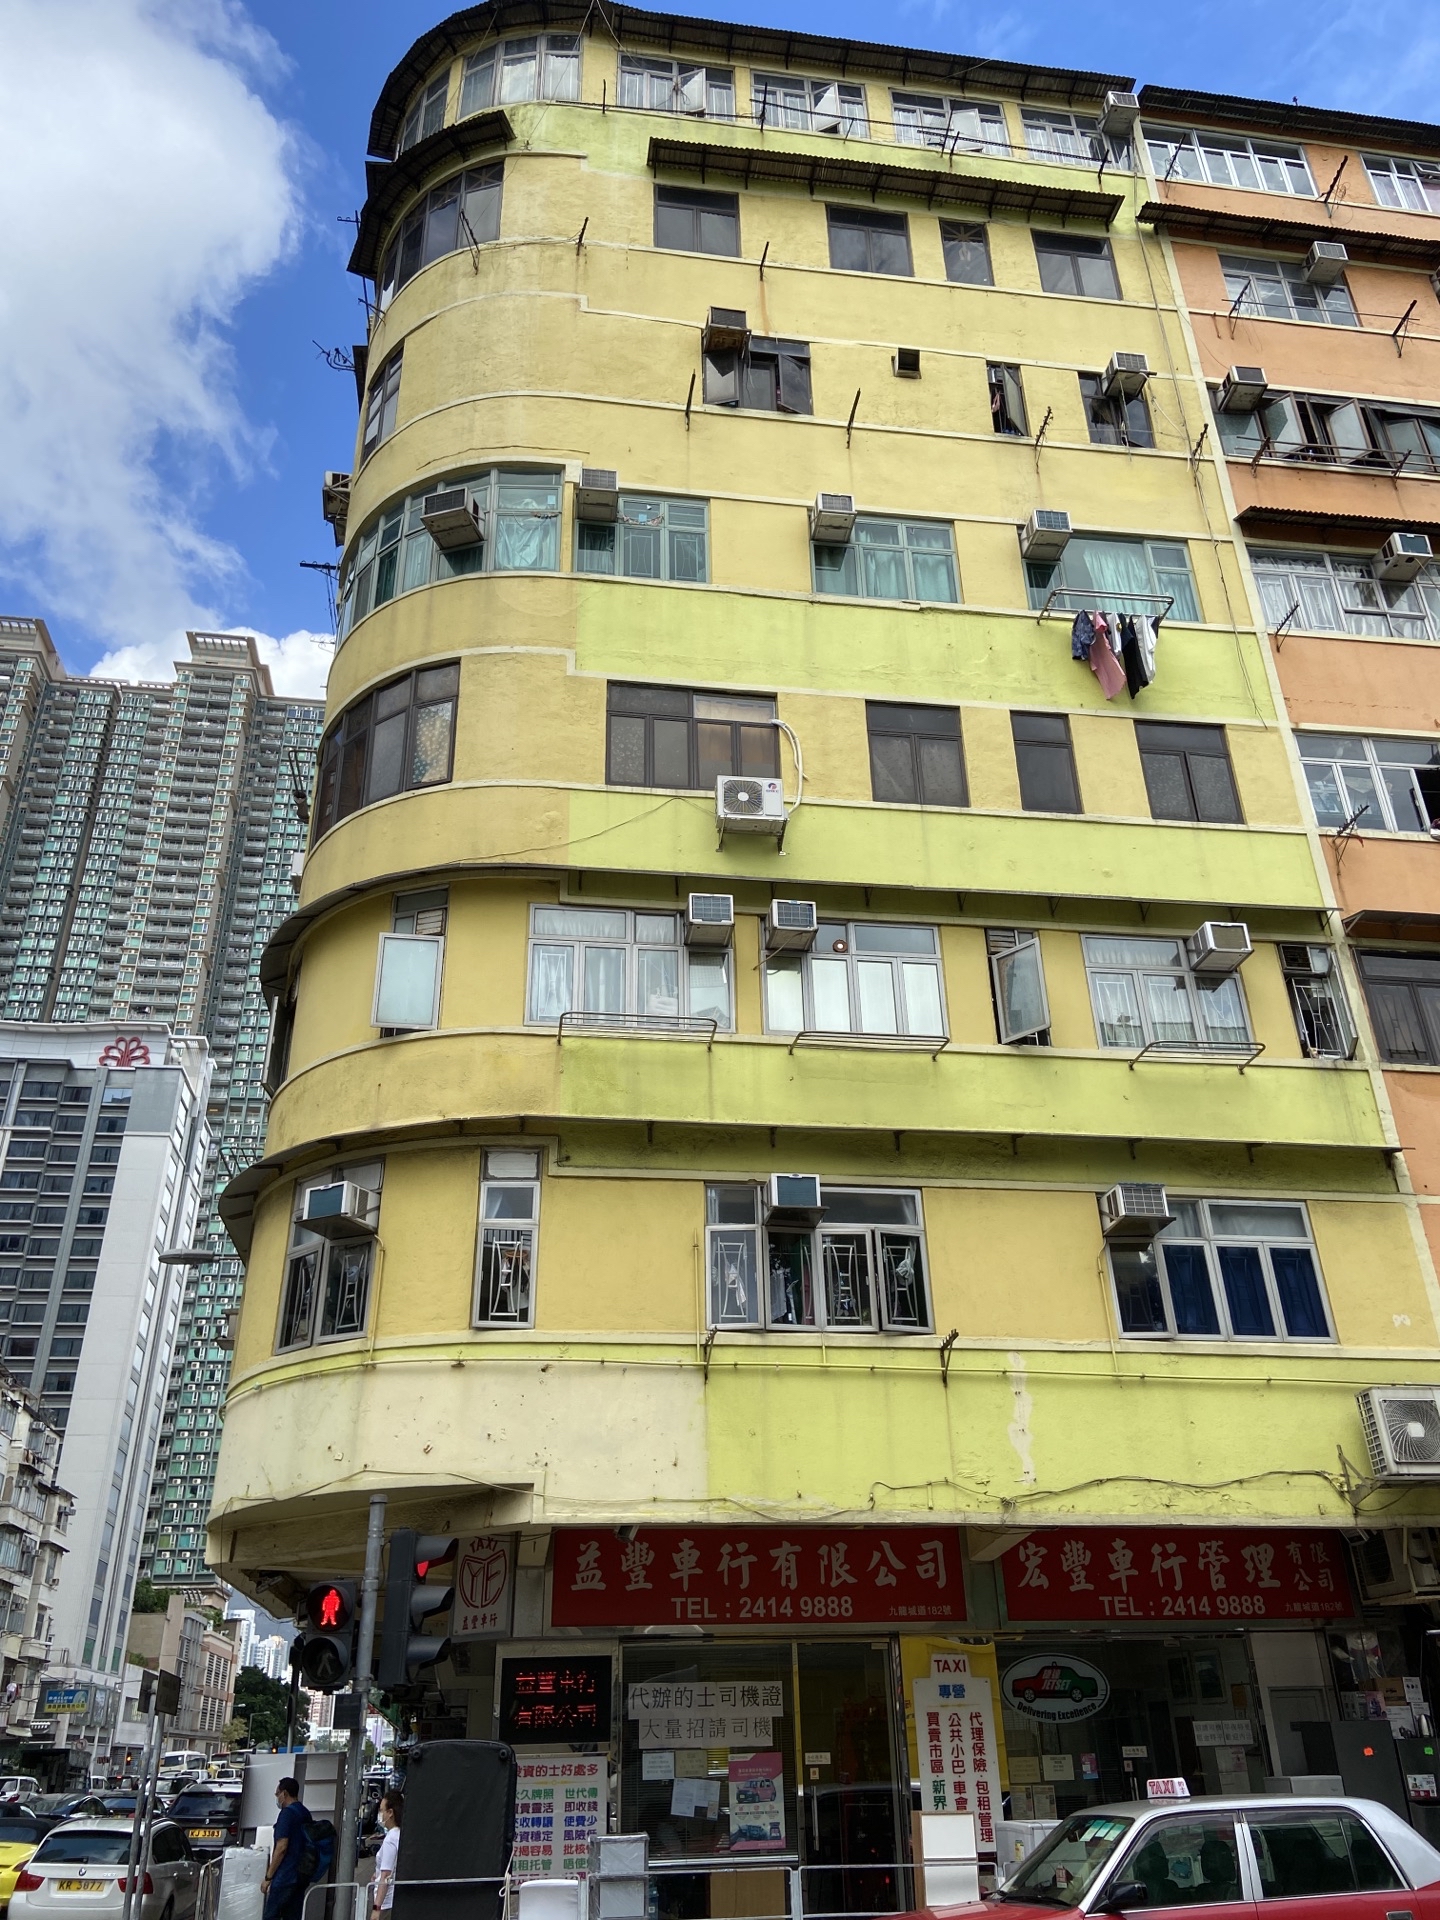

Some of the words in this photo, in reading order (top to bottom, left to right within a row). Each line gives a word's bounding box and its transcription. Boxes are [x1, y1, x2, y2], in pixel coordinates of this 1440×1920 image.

[469, 1536, 498, 1553] TAXI
[1286, 1541, 1331, 1565] 有限
[571, 1538, 947, 1592] 益豐車行有限公司
[1017, 1538, 1281, 1594] 宏豐車行管理
[1293, 1568, 1334, 1592] 公司
[739, 1596, 793, 1618] 2414
[800, 1596, 853, 1617] 9888
[1161, 1596, 1211, 1616] 2414
[1217, 1595, 1266, 1615] 9888
[934, 1659, 967, 1673] TAXI
[630, 1685, 782, 1710] 代辦的士司機證
[1017, 1701, 1057, 1721] Delivering
[1058, 1702, 1097, 1720] Excellence
[642, 1717, 772, 1740] 大量招請司機
[1148, 1780, 1175, 1795] TAXI
[563, 1857, 590, 1869] 唔使
